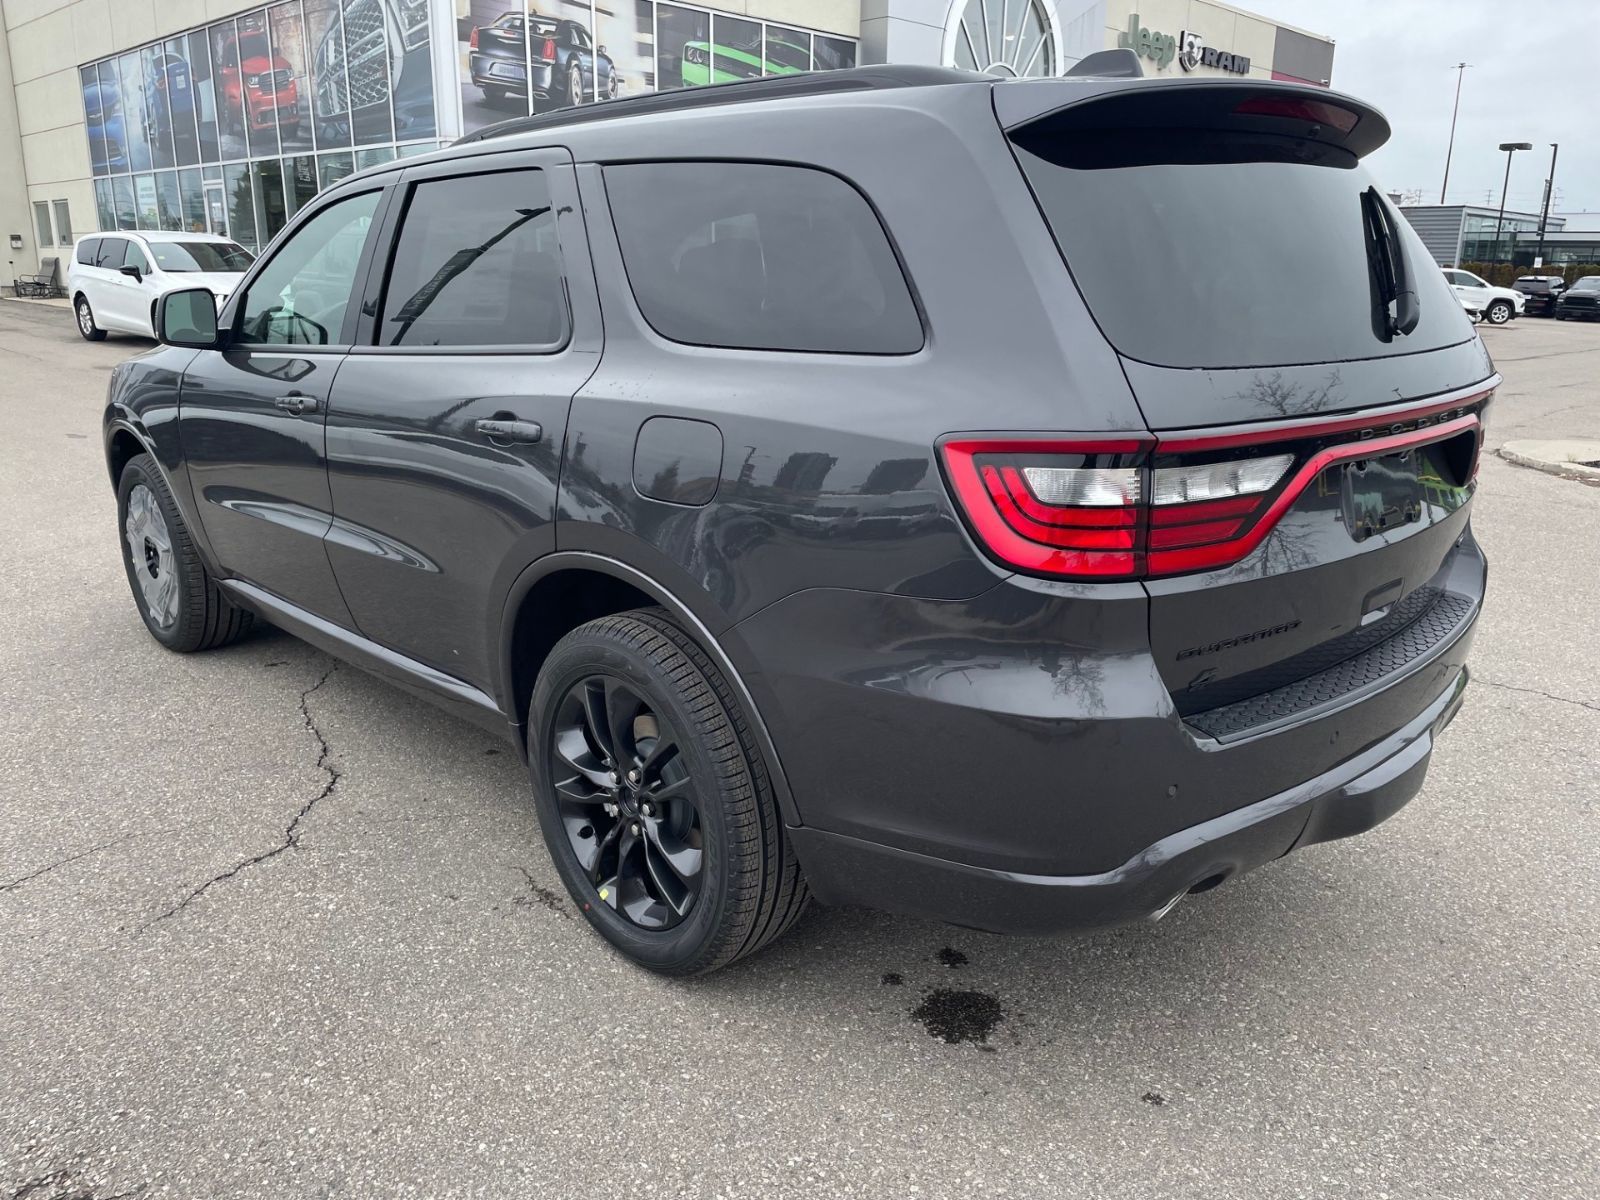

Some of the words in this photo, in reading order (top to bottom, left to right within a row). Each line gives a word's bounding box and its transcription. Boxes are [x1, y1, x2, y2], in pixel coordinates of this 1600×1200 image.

[1119, 14, 1175, 71] Jeep
[1202, 47, 1251, 75] RAM
[1360, 407, 1464, 440] DODGE
